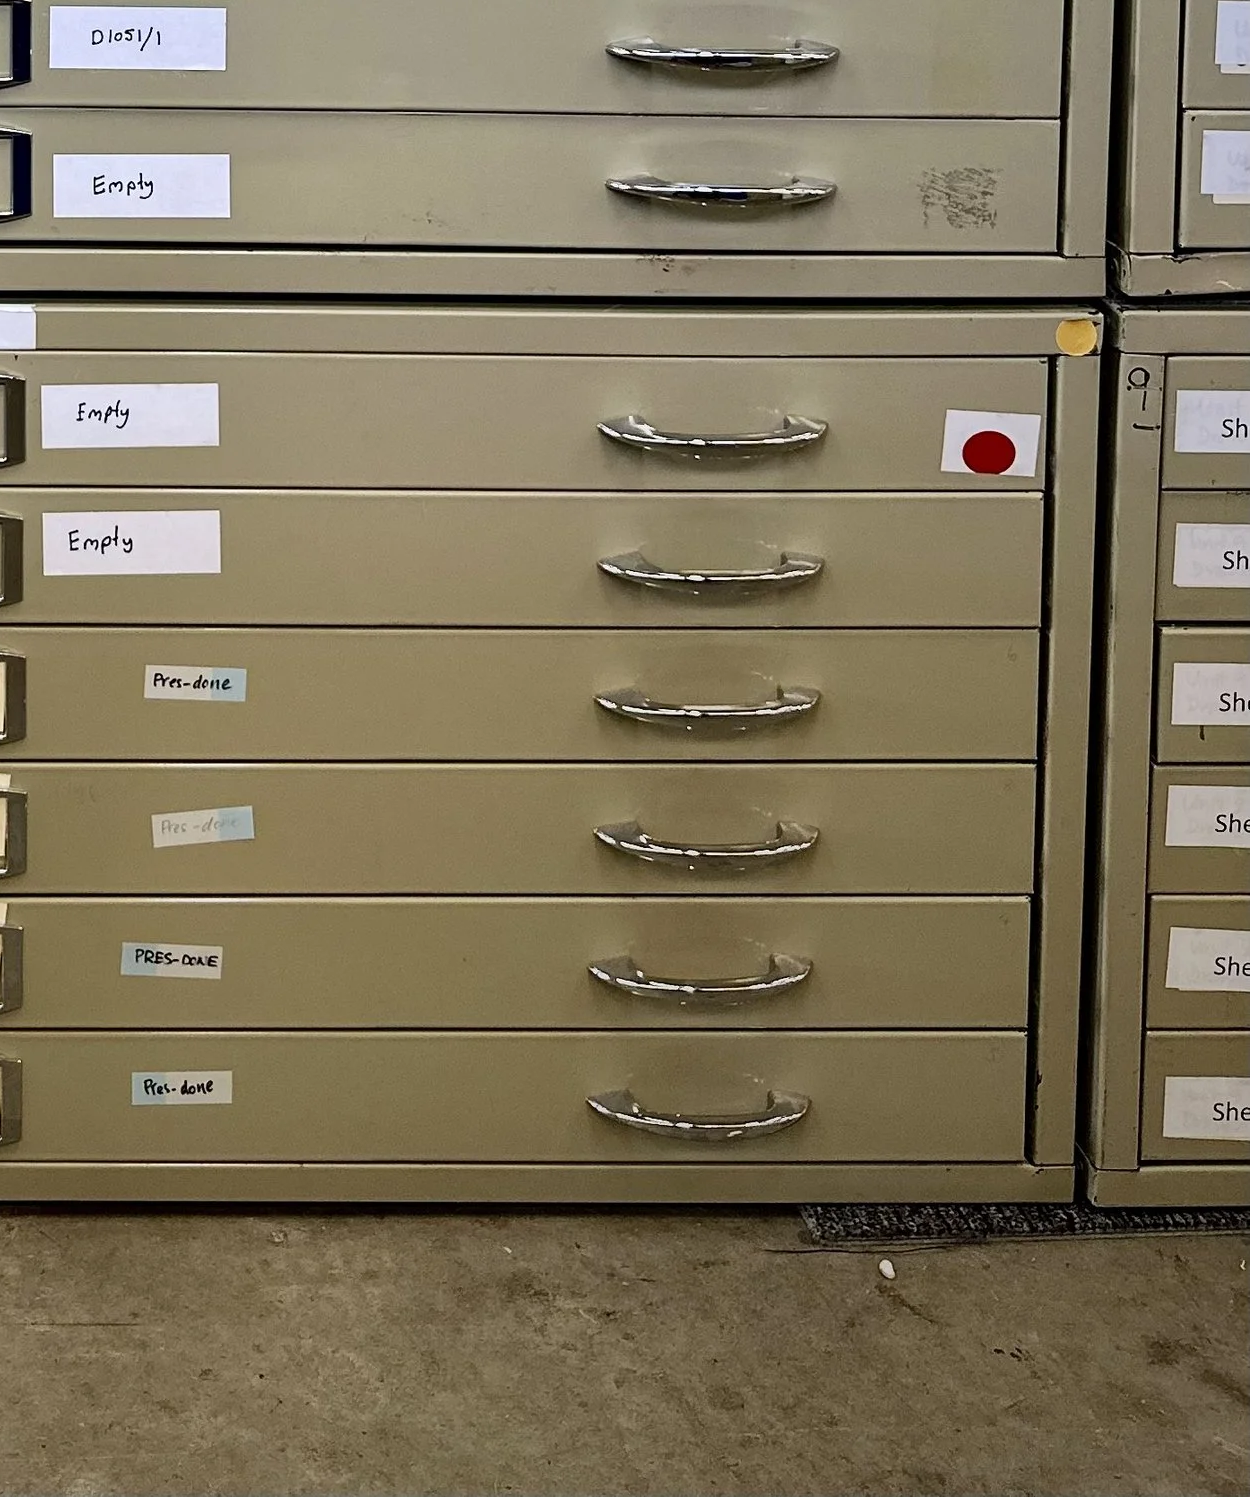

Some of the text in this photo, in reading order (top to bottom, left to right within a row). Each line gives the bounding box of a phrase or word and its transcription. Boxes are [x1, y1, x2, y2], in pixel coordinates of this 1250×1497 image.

[92, 27, 161, 52] D1051/1
[93, 174, 154, 200] Empty
[76, 402, 130, 429] Empty
[68, 529, 133, 555] Empty
